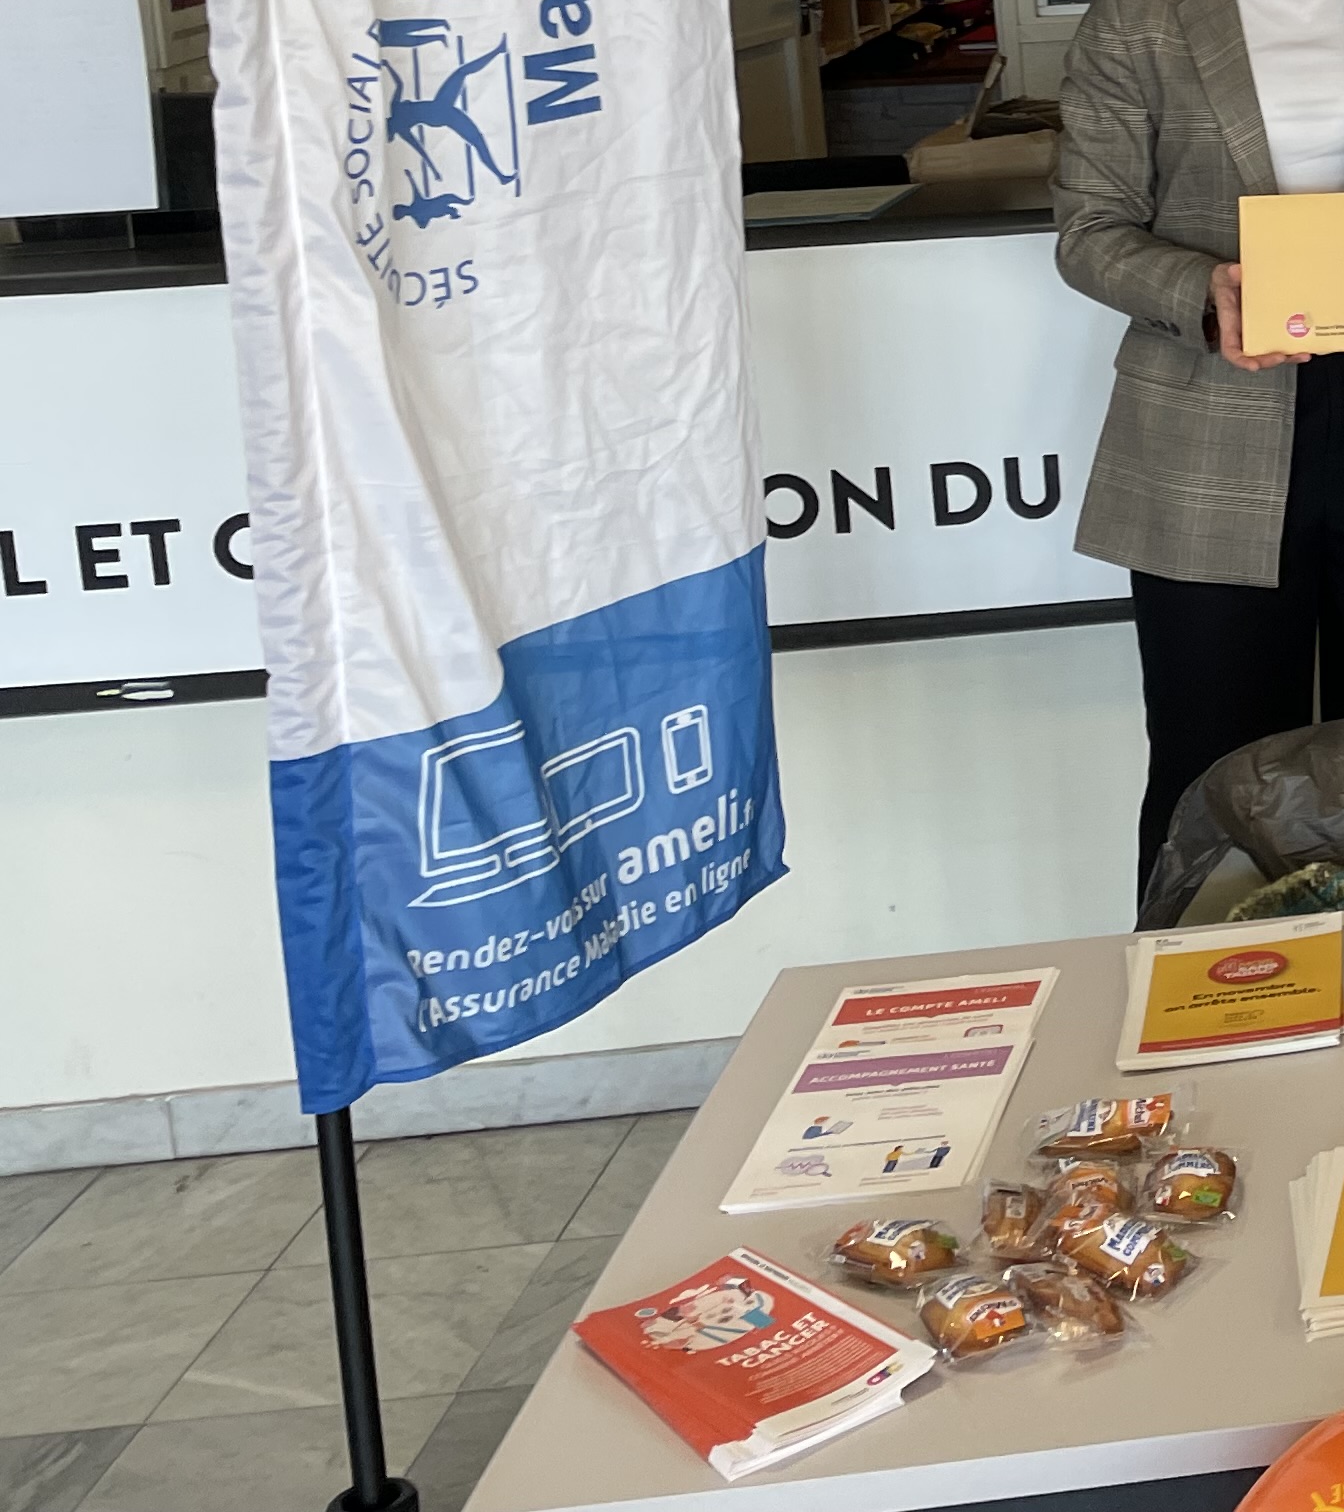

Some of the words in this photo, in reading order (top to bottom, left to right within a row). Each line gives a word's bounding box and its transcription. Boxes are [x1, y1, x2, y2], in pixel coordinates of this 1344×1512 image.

[931, 454, 1062, 526] DU
[75, 518, 181, 591] ET
[581, 872, 607, 912] sur
[665, 883, 698, 913] en
[701, 847, 752, 895] ligne
[865, 1007, 884, 1017] LE
[888, 1000, 955, 1014] COMPTE
[957, 995, 1008, 1007] AMELI
[1164, 1004, 1186, 1014] on
[1188, 997, 1237, 1010] arrête
[1192, 993, 1214, 1002] En
[1217, 982, 1297, 998] novembre
[808, 1064, 948, 1086] ACCOMPAGNEMENT
[950, 1058, 996, 1071] SANTÉ
[715, 1330, 792, 1367] TABAC
[791, 1311, 819, 1331] ET
[741, 1319, 831, 1369] CANCER
